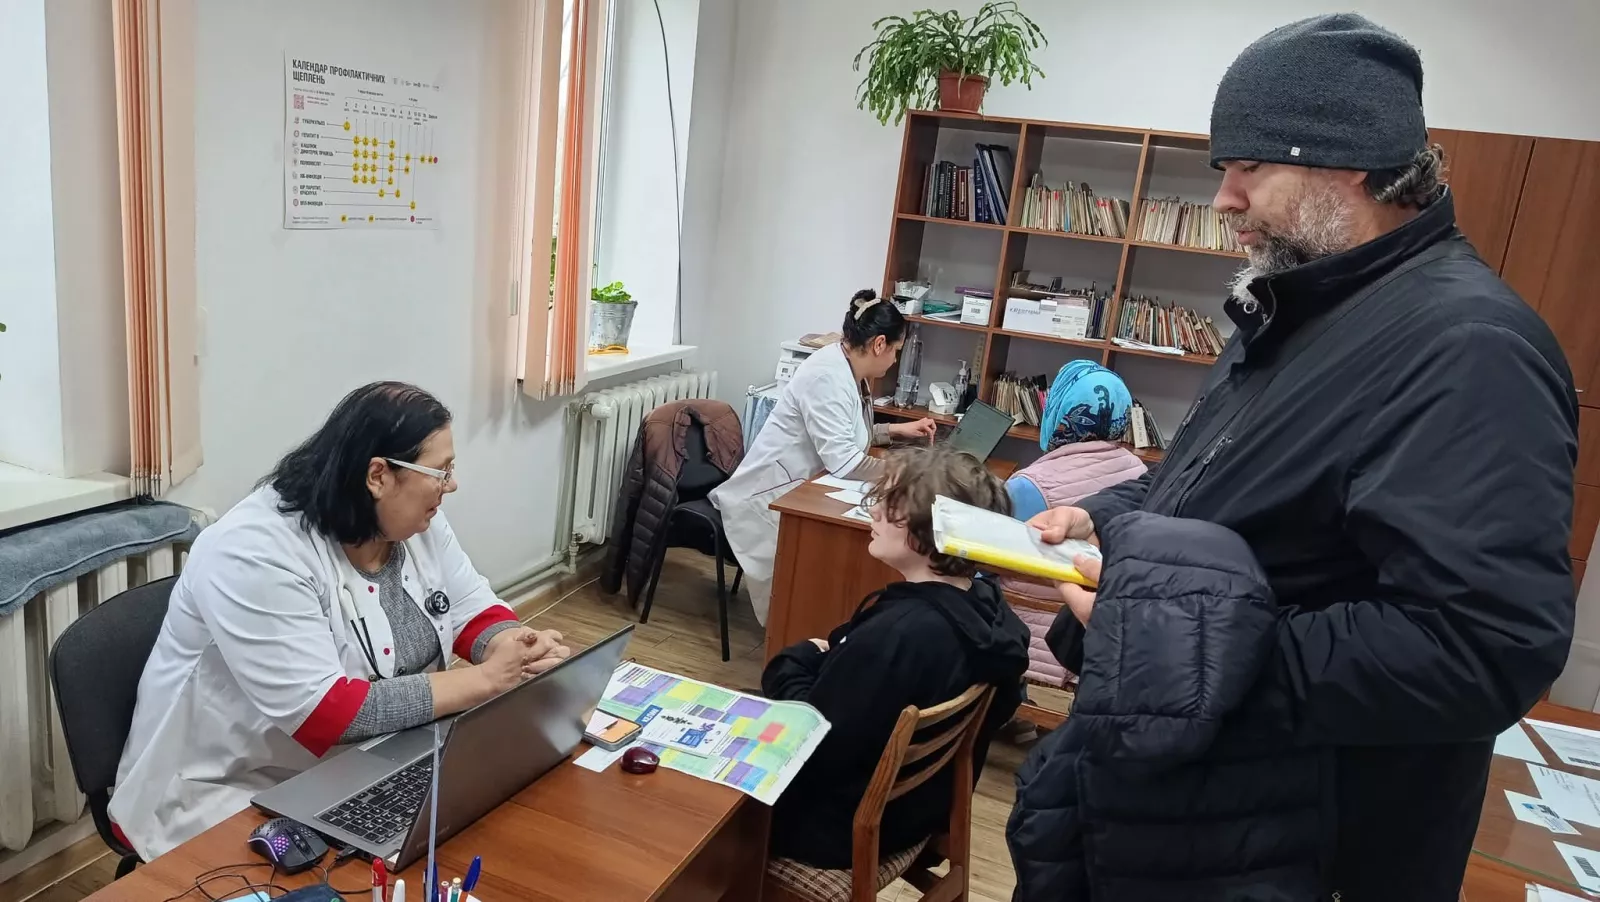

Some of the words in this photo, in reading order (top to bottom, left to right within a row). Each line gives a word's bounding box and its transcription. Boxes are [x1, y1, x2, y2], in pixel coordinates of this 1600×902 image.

[292, 58, 328, 75] КАЛЕНДАР
[329, 65, 386, 84] ПРОФІЛАКТИЧНИХ
[292, 70, 326, 85] ЩЕПЛЕНЬ
